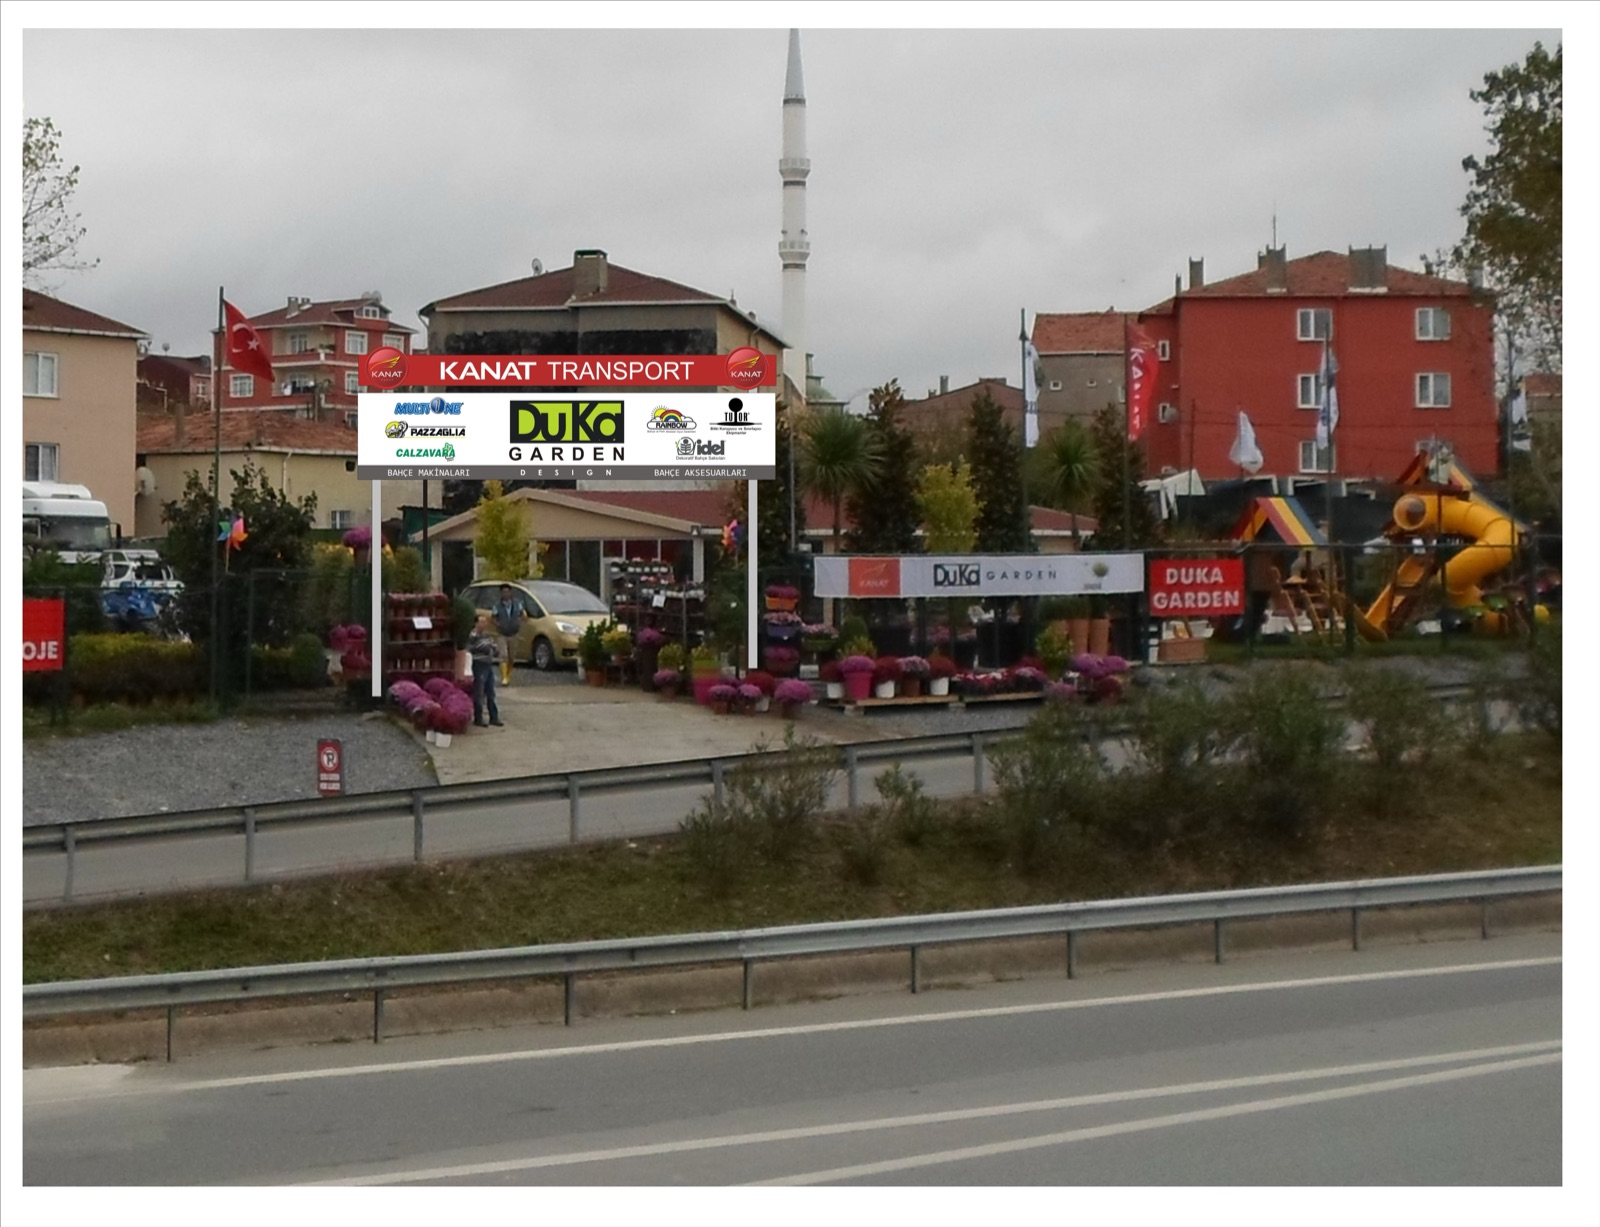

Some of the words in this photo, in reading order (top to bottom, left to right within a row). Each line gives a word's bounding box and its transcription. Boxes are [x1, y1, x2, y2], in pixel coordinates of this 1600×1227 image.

[371, 370, 403, 378] KANAT
[440, 361, 537, 381] KANAT
[547, 361, 695, 381] TRANSPORT
[410, 428, 466, 437] PAZZAGLIA
[697, 439, 725, 455] idel
[396, 448, 456, 458] CALZAVARA
[509, 447, 625, 461] GARDEN
[387, 469, 413, 478] BAHÇE
[418, 467, 470, 477] MAKİNALARI
[520, 469, 612, 477] DESIGN
[654, 469, 680, 478] BAHÇE
[685, 469, 747, 477] AKSESUARLARI
[986, 570, 1058, 581] GARDEN
[1166, 567, 1224, 585] DUKA
[1152, 590, 1239, 609] GARDEN
